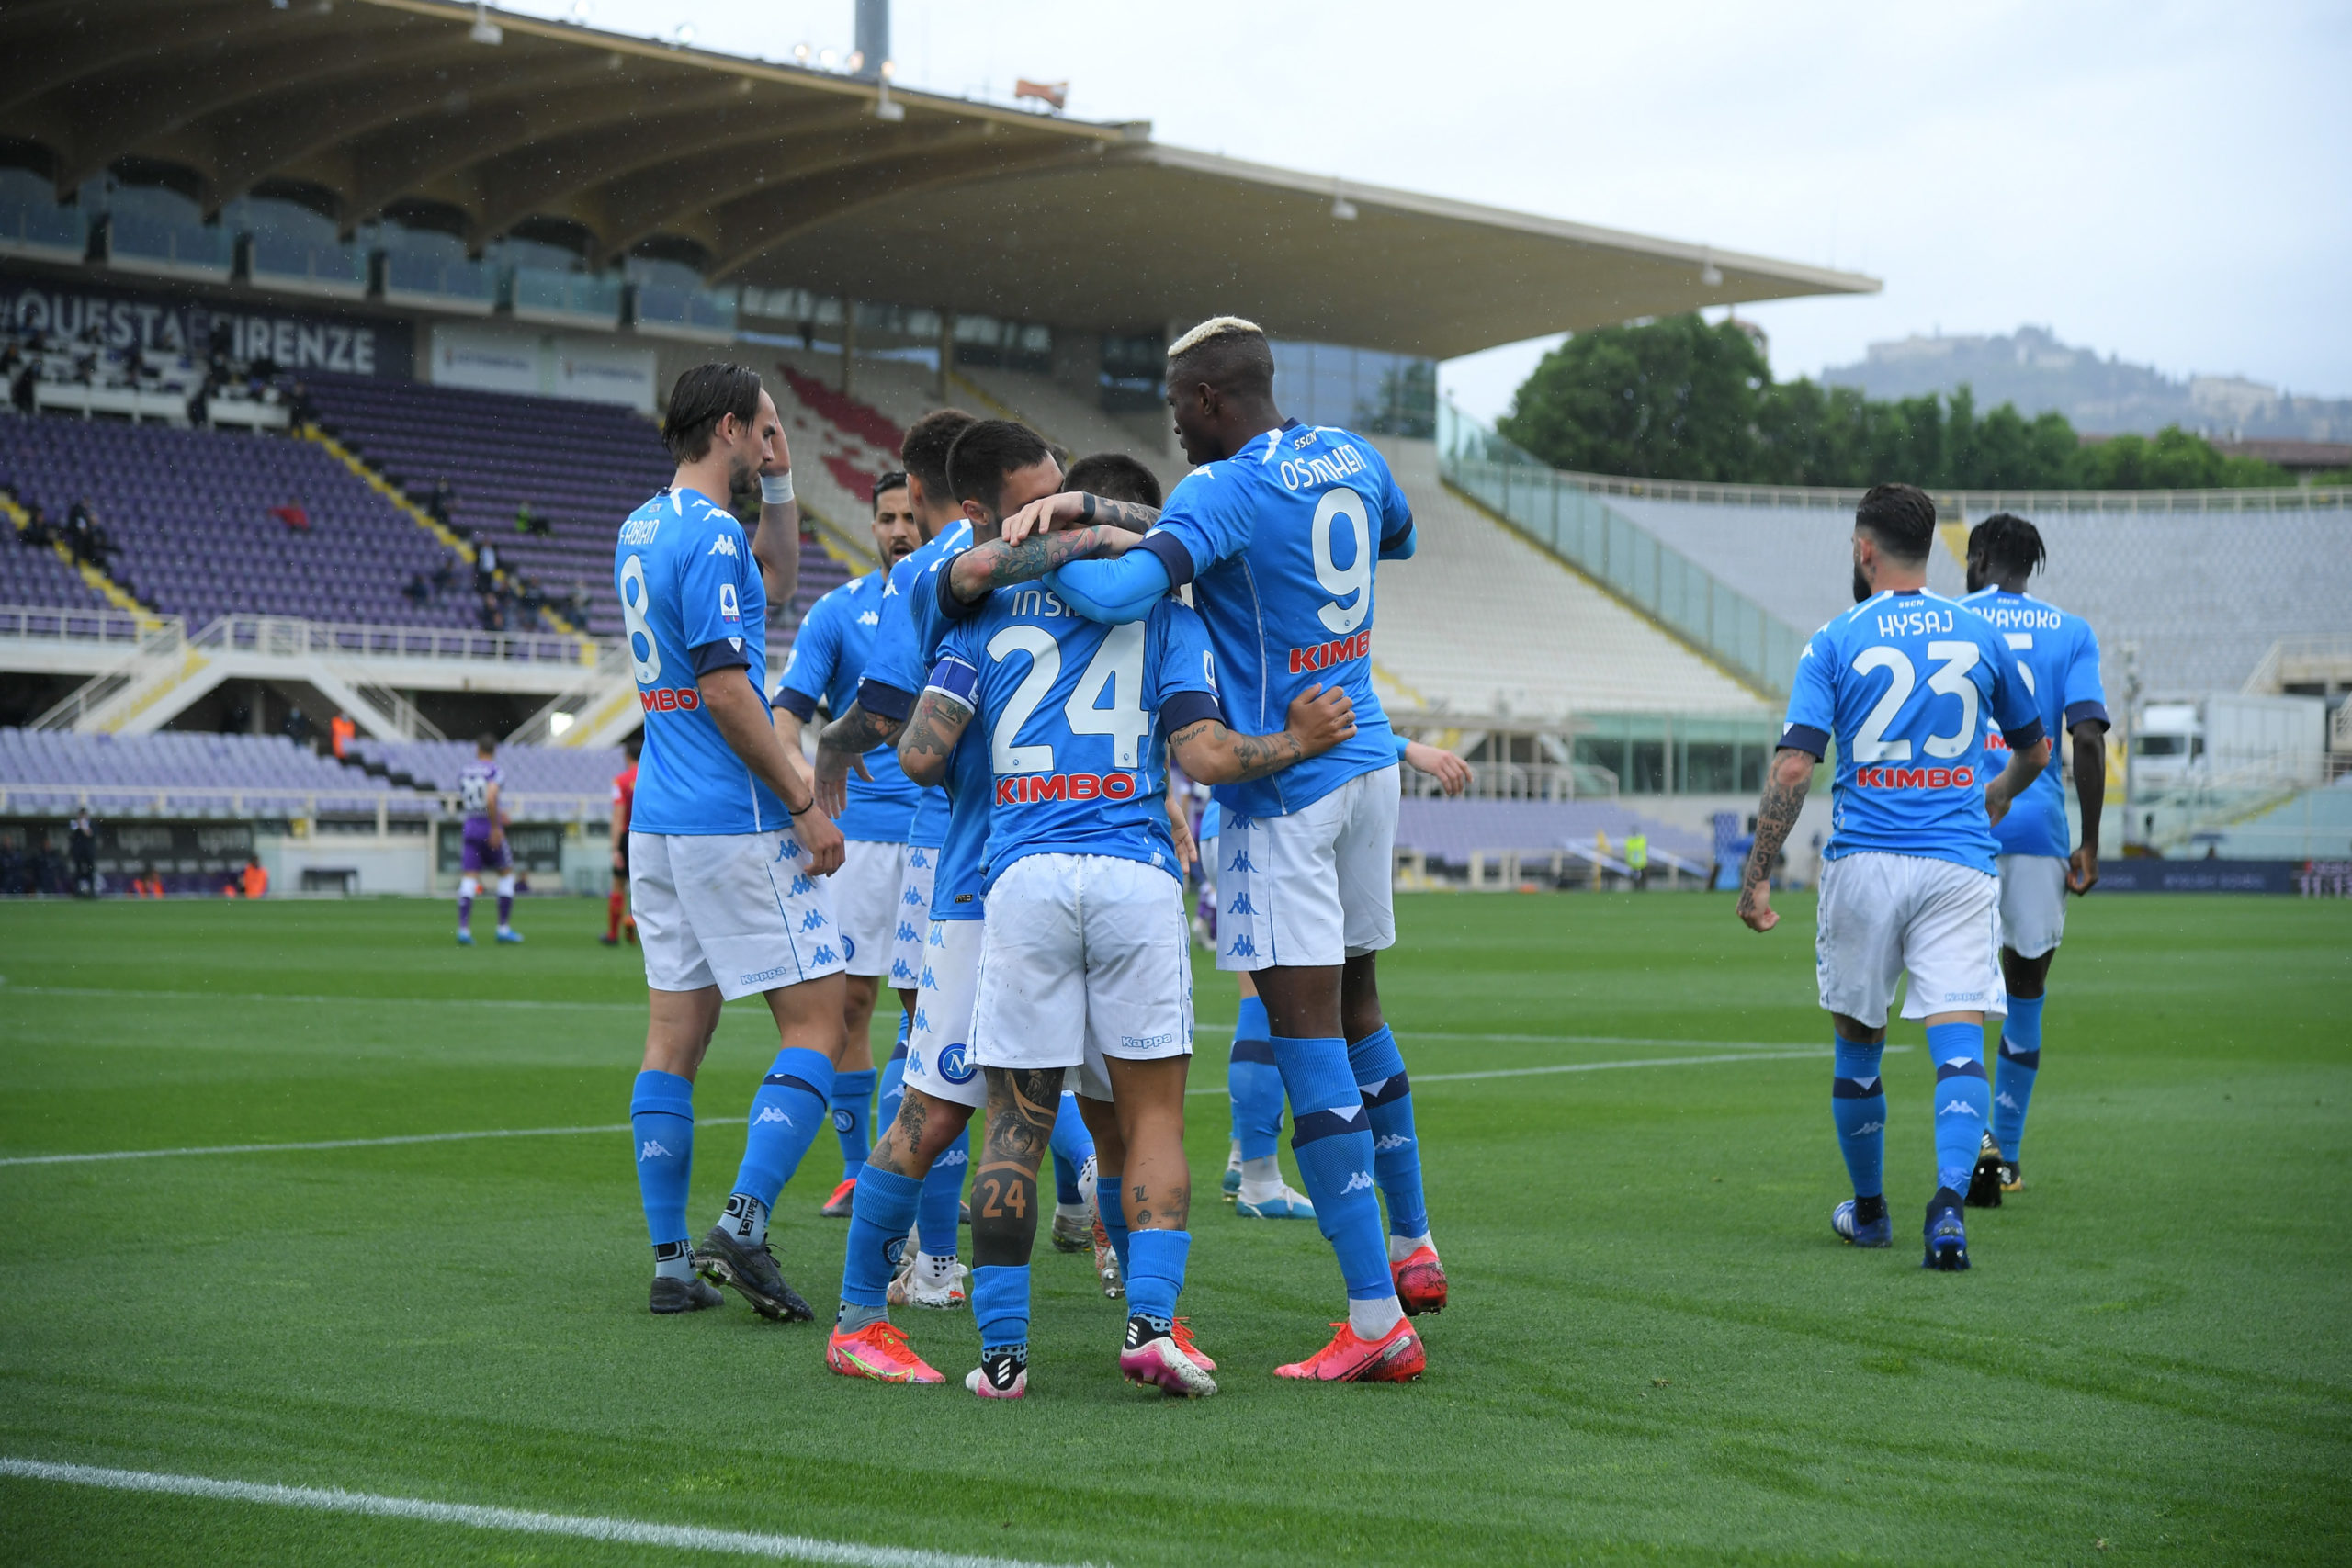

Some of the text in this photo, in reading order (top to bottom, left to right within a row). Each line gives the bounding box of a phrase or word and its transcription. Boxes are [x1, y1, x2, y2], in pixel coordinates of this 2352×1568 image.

[1294, 431, 1317, 450] SSCN
[618, 519, 660, 545] FABIAN
[1312, 488, 1370, 634] 9
[620, 554, 661, 684] 8
[1877, 610, 1953, 637] HYSAJ
[1972, 606, 2061, 630] KAYOKO
[1289, 629, 1371, 674] KIMB
[639, 688, 699, 712] MBO
[986, 620, 1149, 774] 24
[1852, 641, 1980, 762] 23
[996, 773, 1136, 806] KIMBO
[1857, 765, 1975, 790] KIMBO
[740, 966, 786, 986] Kappa
[1121, 1033, 1173, 1049] Kappa
[982, 1179, 1026, 1219] 24
